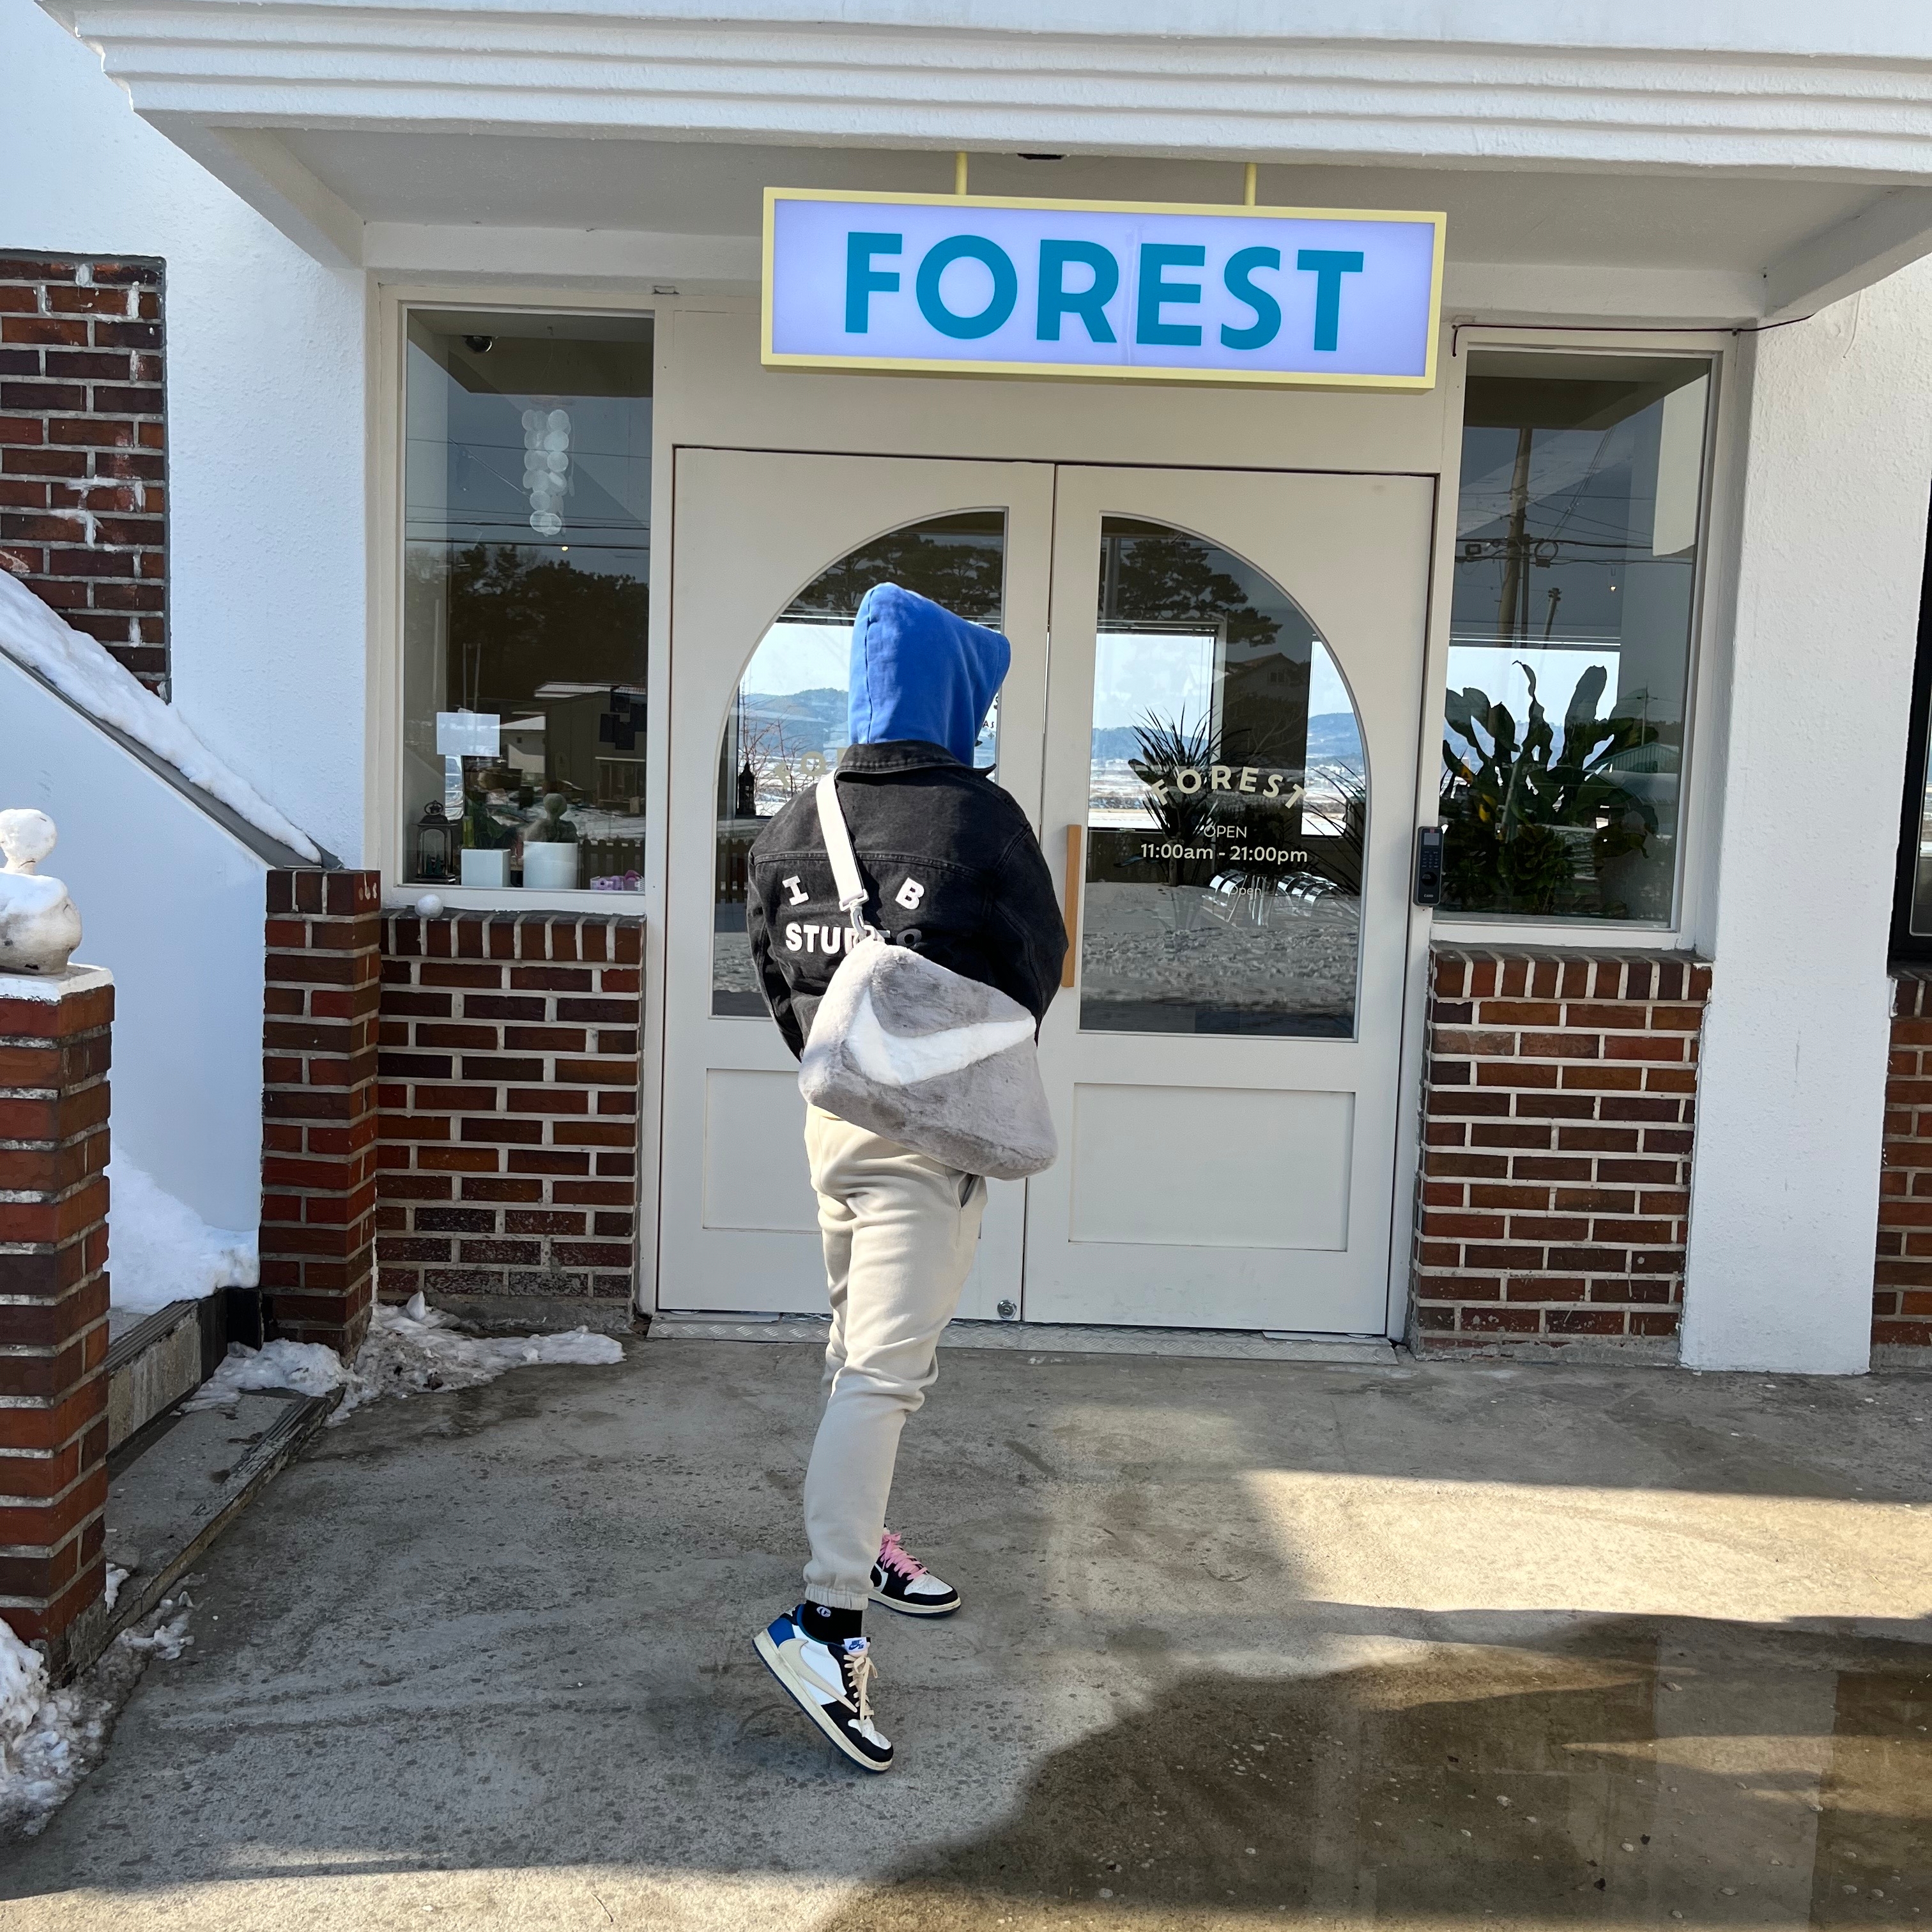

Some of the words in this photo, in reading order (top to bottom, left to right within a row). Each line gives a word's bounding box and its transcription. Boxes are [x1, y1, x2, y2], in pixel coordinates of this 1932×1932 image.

[845, 231, 1365, 352] FOREST
[1151, 765, 1308, 809] FOREST
[1203, 825, 1247, 838] OPEN
[1140, 843, 1213, 859] 11:00am
[1230, 845, 1308, 865] 21:00pm
[785, 922, 922, 954] STUO
